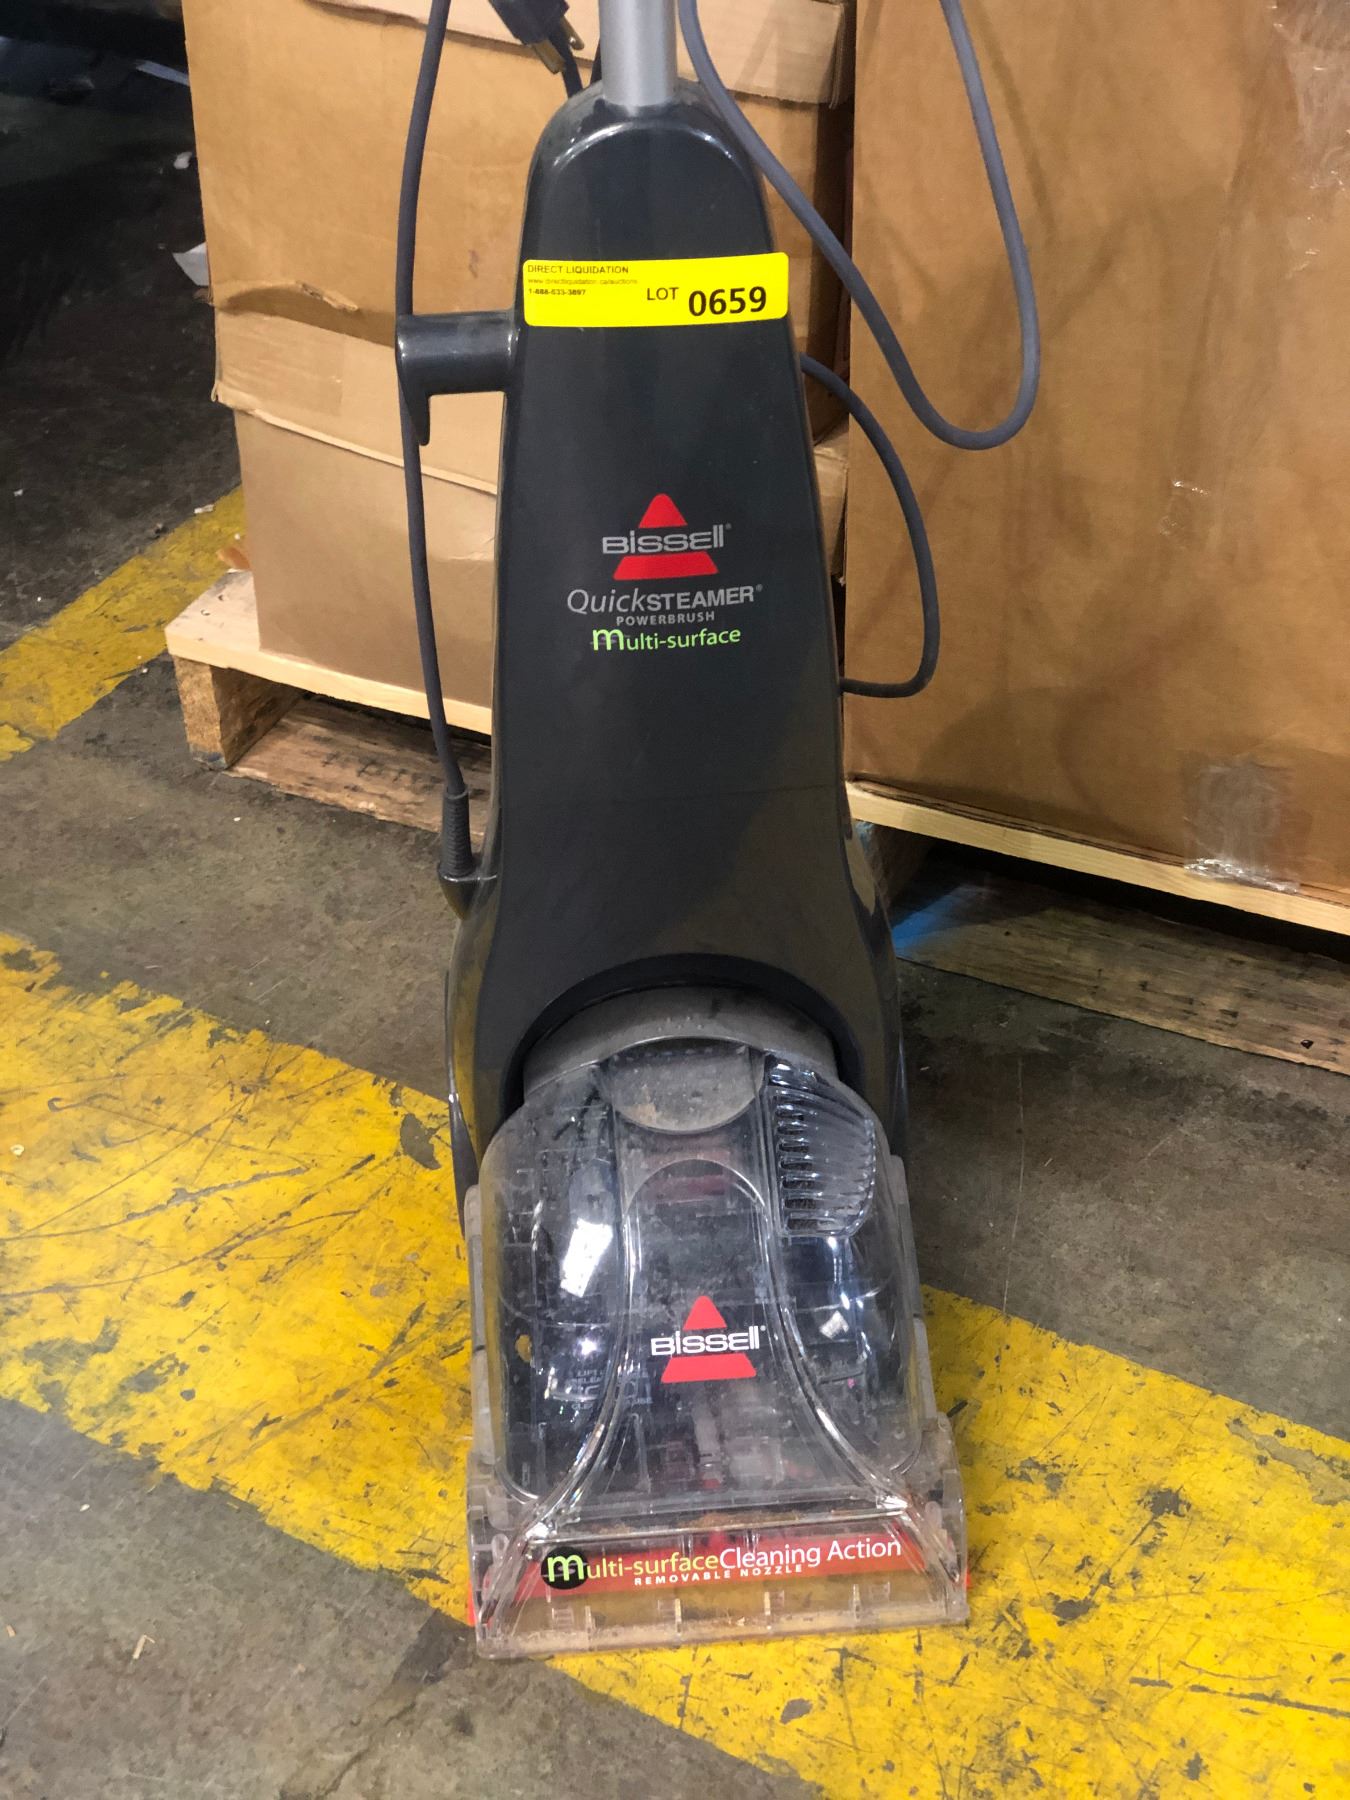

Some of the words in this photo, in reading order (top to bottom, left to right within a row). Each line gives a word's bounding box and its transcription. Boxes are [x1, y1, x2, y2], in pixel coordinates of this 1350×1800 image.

[527, 264, 563, 274] DIRECT
[566, 265, 629, 274] LIQUIDATION
[646, 287, 679, 301] LOT
[688, 286, 767, 317] 0659
[616, 611, 716, 627] POWERBRUSH
[827, 1538, 902, 1562] Action
[634, 1569, 731, 1586] REMOVABLE
[740, 1564, 802, 1577] NOZZLE
